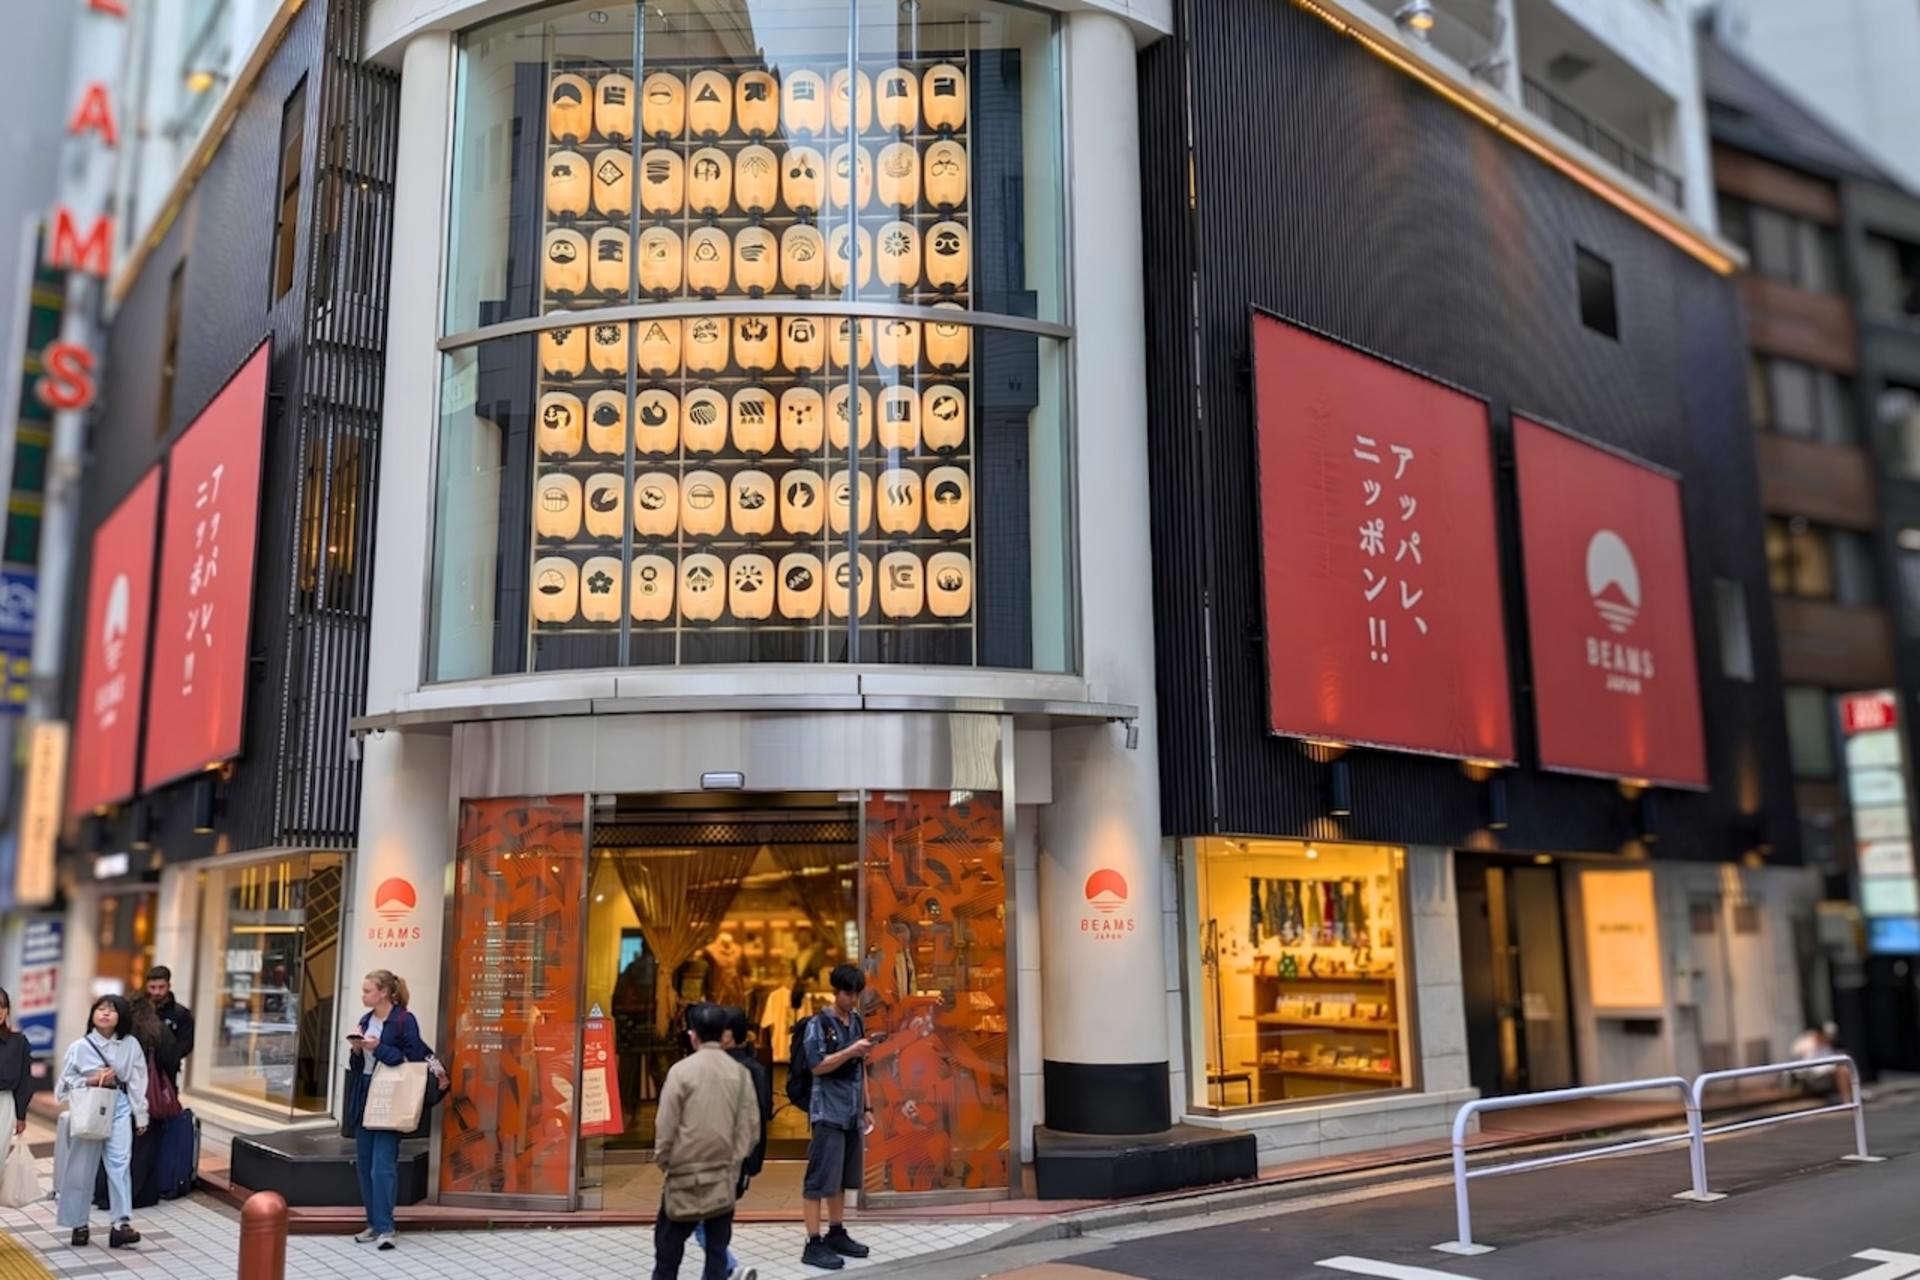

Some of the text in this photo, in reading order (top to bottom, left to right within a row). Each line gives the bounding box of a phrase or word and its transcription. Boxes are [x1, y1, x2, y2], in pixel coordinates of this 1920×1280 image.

[1389, 443, 1429, 634] アッパレ、
[1586, 635, 1655, 679] BEAMS
[367, 926, 421, 940] BEAMS
[1080, 918, 1135, 932] BEAMS
